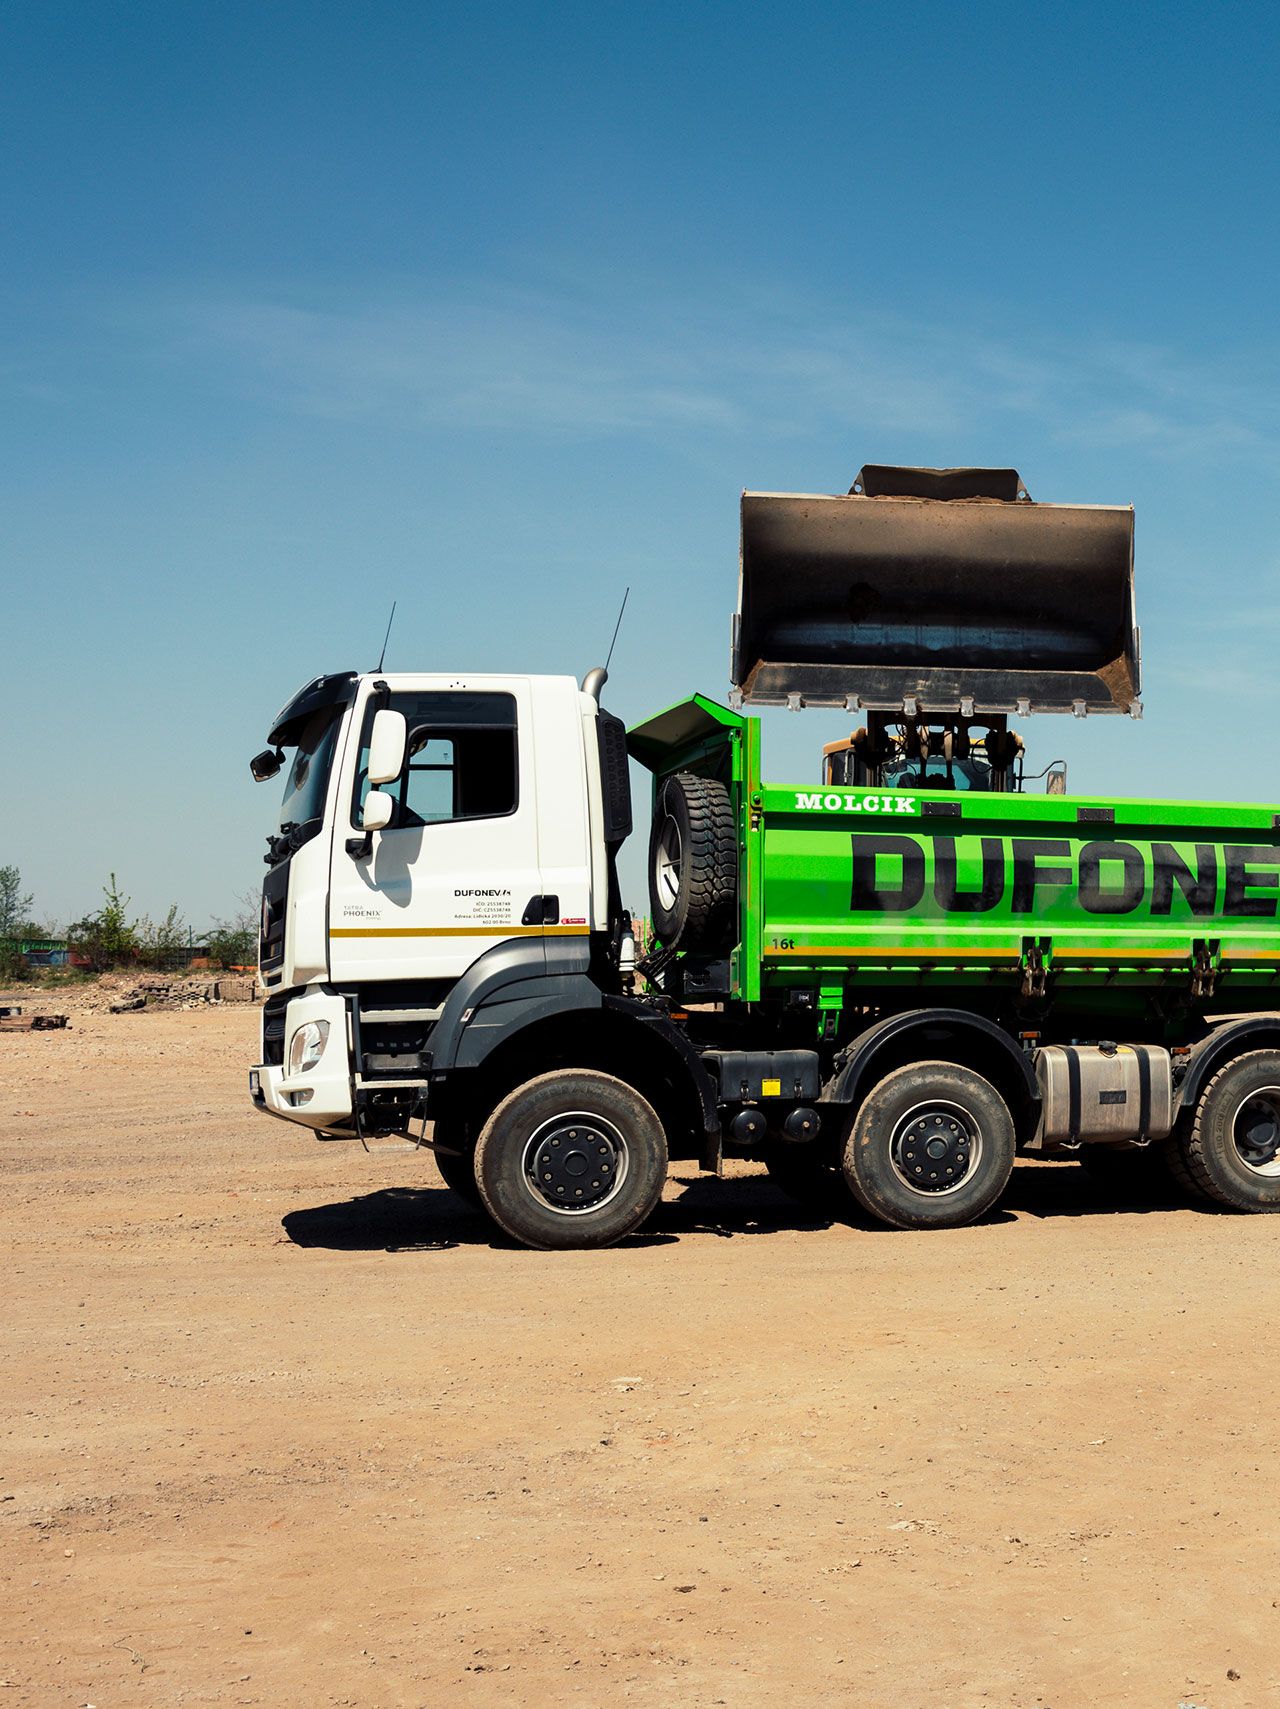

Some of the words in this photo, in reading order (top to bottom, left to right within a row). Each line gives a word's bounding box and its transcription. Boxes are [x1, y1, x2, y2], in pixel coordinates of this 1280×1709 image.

[795, 792, 916, 813] MOLCIK
[454, 889, 501, 897] DUFONEV
[772, 938, 795, 950] 16t
